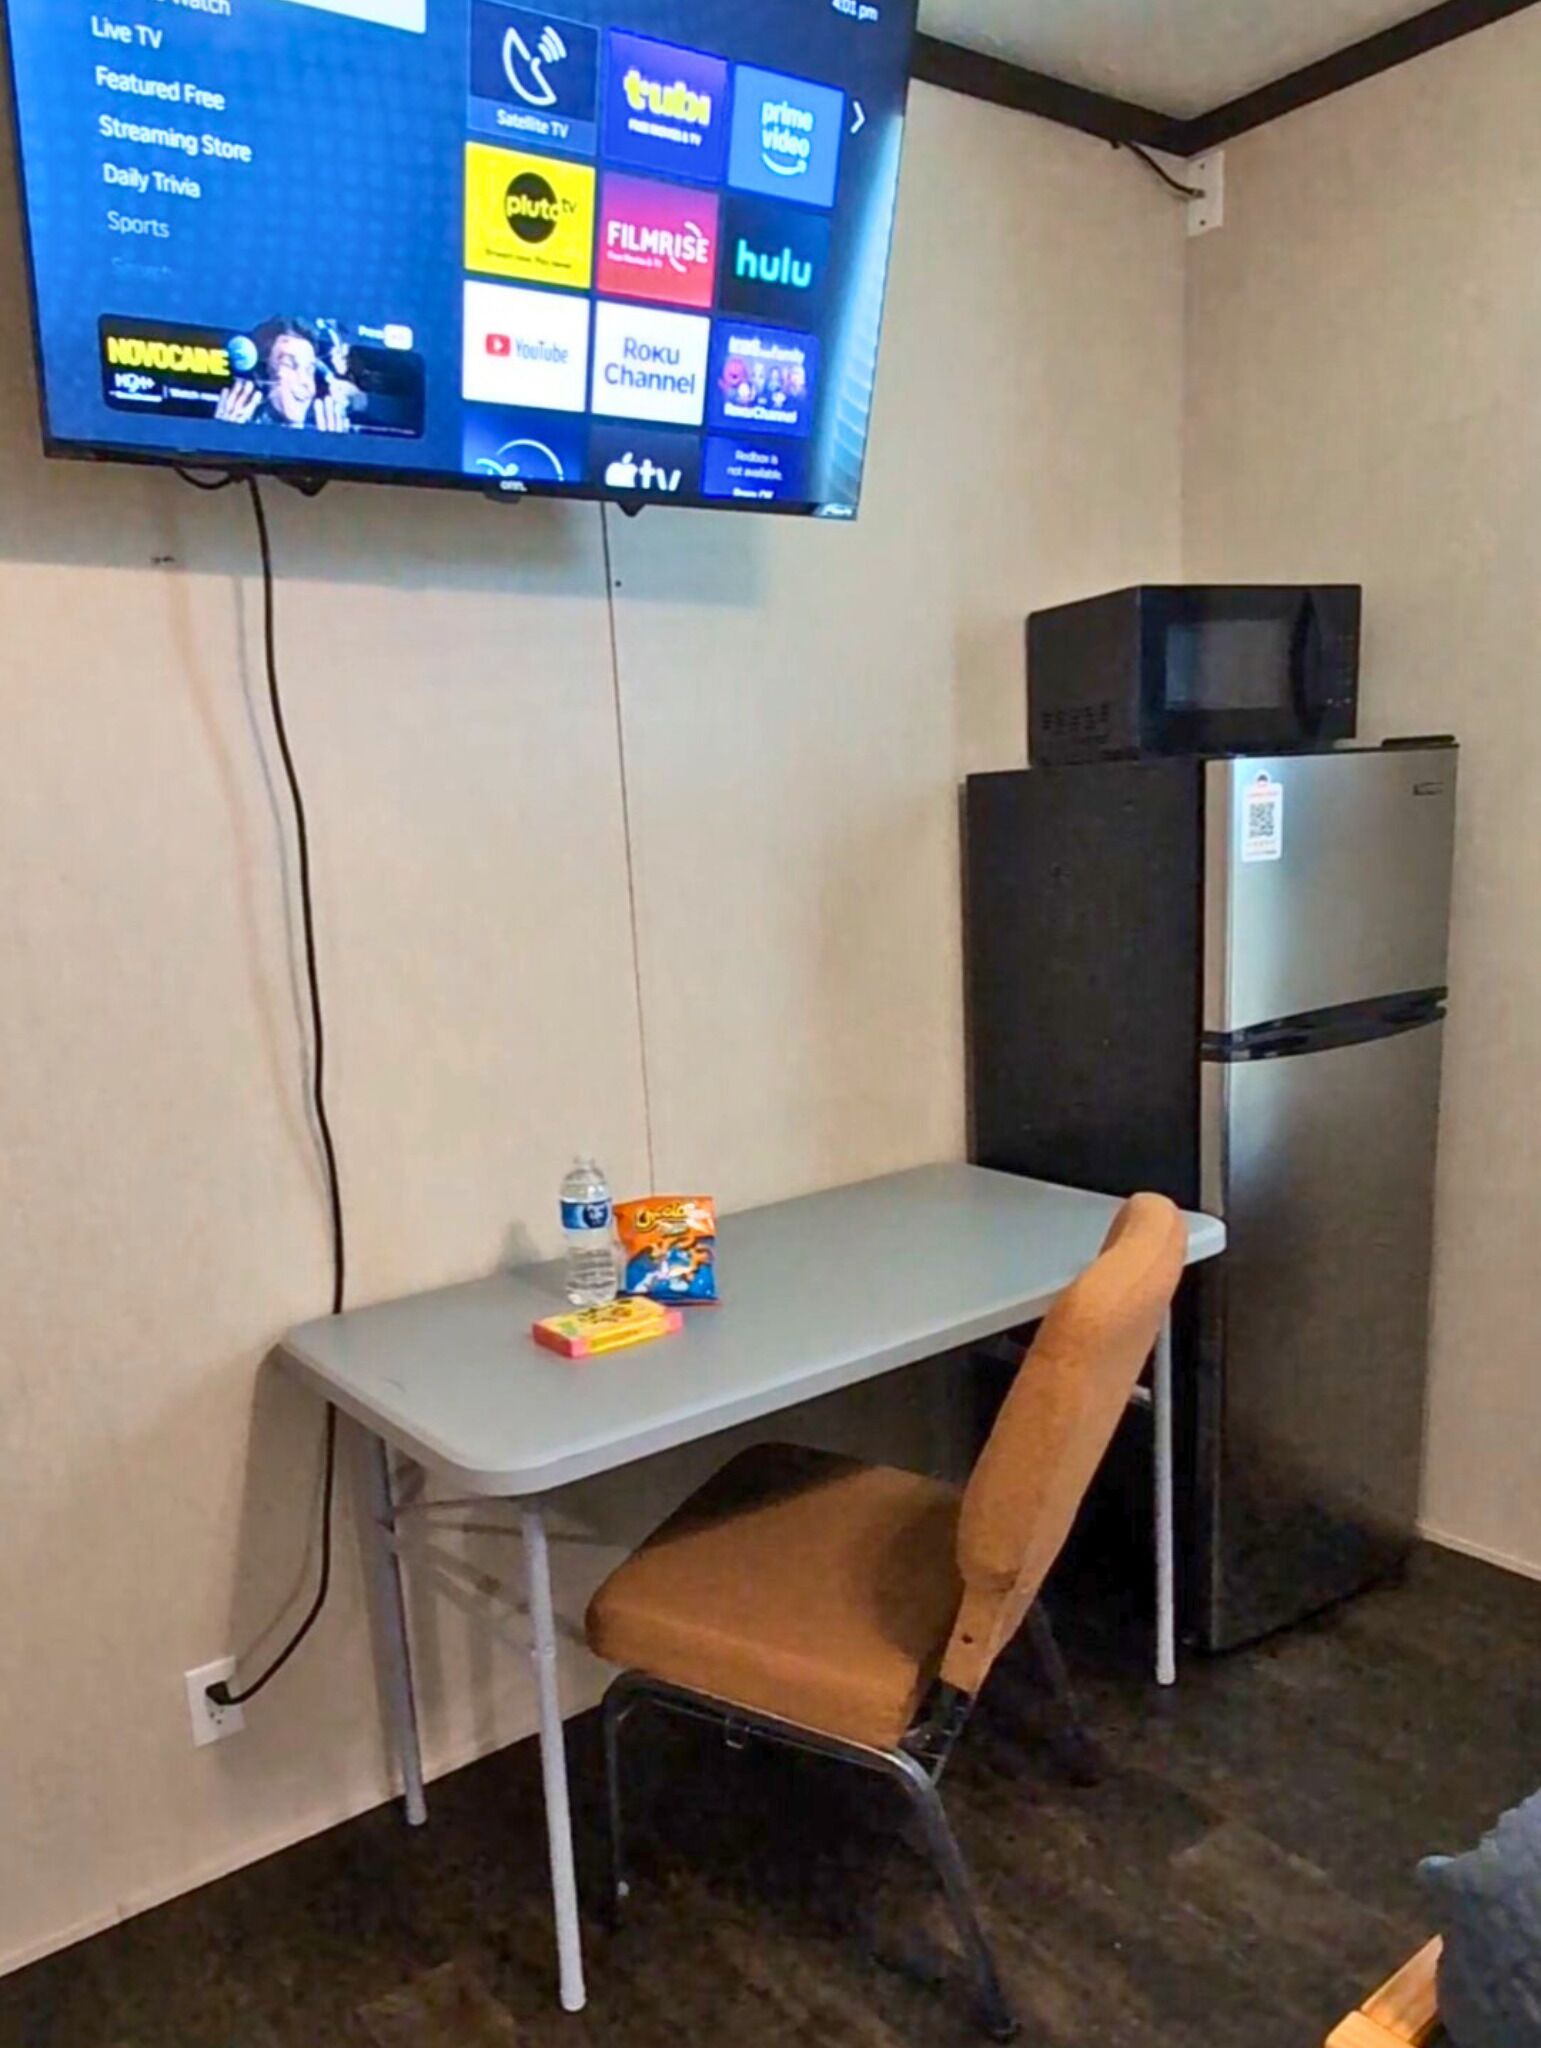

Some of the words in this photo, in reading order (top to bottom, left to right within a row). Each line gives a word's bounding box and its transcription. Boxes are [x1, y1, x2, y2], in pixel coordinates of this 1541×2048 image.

[91, 15, 132, 43] Live
[134, 24, 162, 49] TV
[95, 65, 180, 101] Featured
[183, 83, 225, 111] Free
[624, 69, 711, 127] tubi
[496, 108, 550, 136] Satellite
[551, 120, 570, 139] TV
[762, 100, 814, 132] prime
[98, 114, 199, 157] Streaming
[201, 133, 252, 163] Store
[762, 126, 811, 159] video
[102, 162, 149, 193] Daily
[151, 170, 202, 199] Trivia
[106, 209, 170, 239] Sports
[506, 194, 561, 221] pluto
[607, 219, 710, 272] FILMRISE
[736, 238, 812, 288] hulu
[515, 337, 568, 364] YouTube
[622, 336, 681, 366] Roku
[604, 361, 696, 395] Channel
[639, 458, 682, 491] tv
